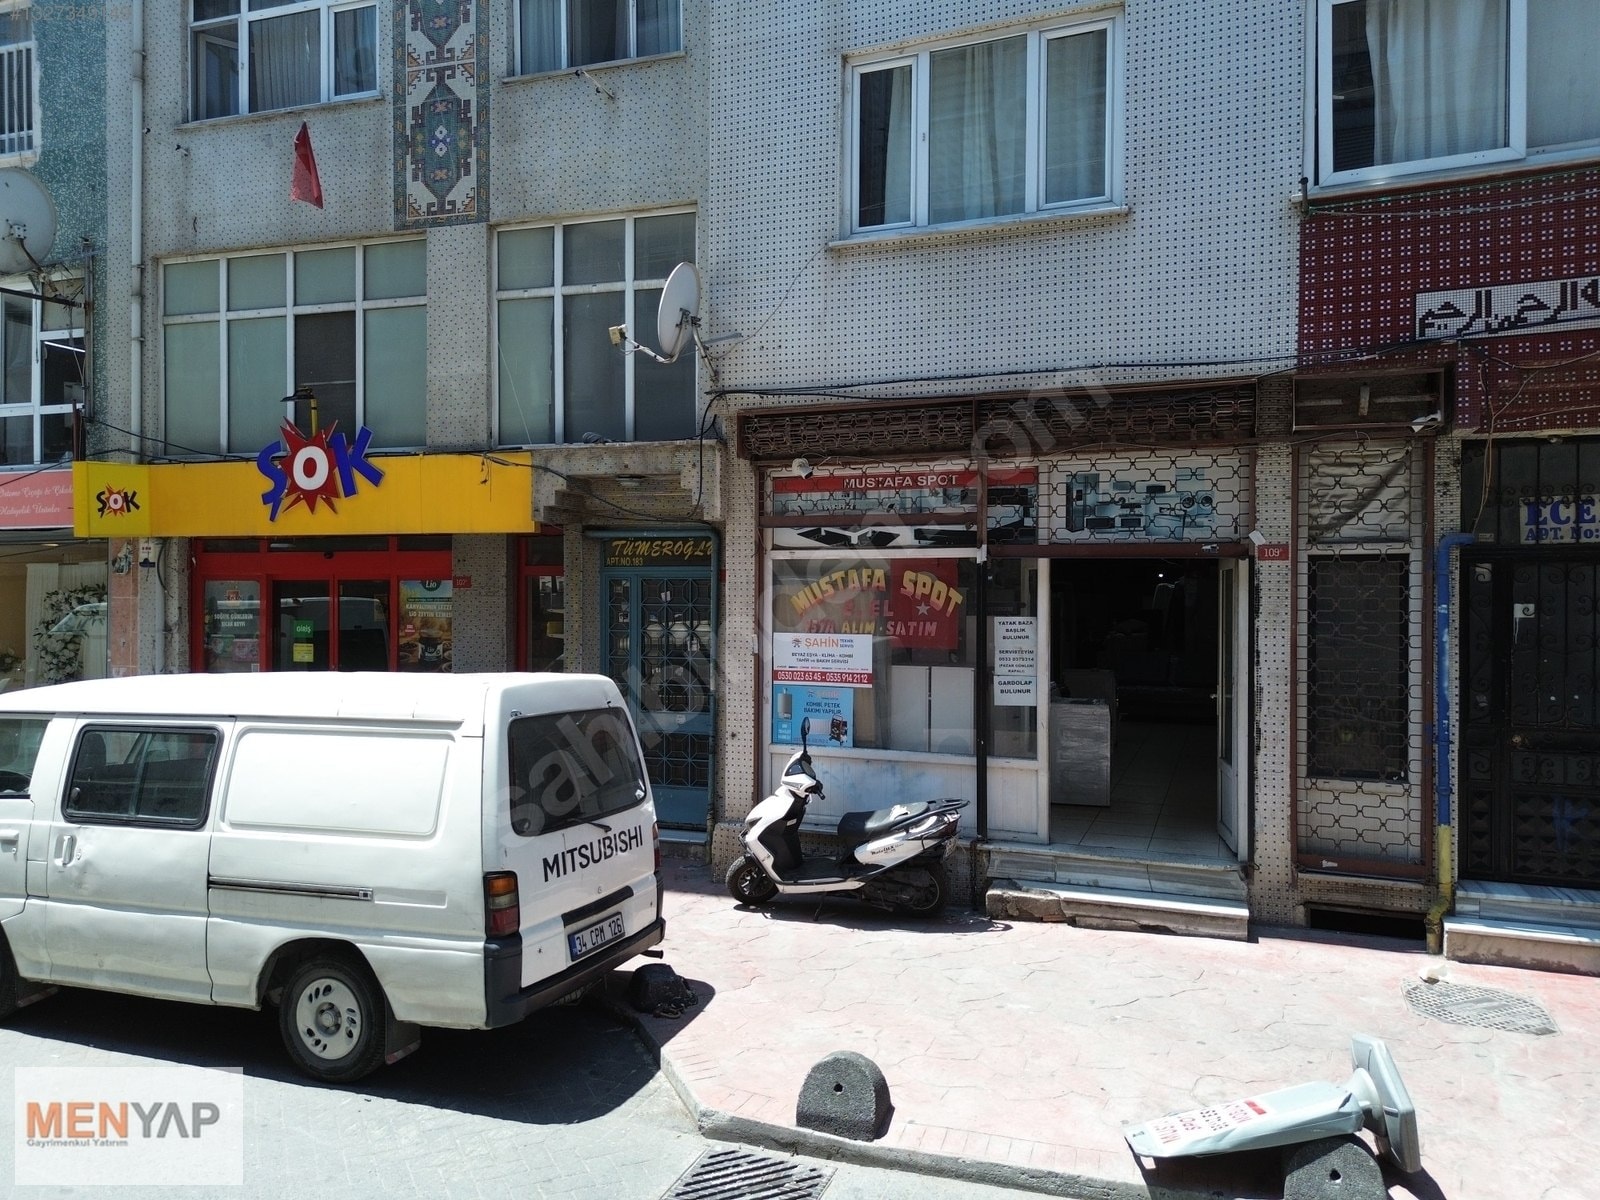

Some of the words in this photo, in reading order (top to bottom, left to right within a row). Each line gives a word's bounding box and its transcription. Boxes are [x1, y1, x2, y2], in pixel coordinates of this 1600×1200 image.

[256, 425, 385, 522] ŞOK
[843, 475, 913, 489] MUSTAFA
[917, 474, 958, 486] SPOT
[96, 490, 141, 518] ŞOK
[790, 568, 886, 618] MUSTAFA
[900, 570, 963, 617] SPOT
[804, 636, 839, 650] ŞAHİN
[886, 621, 938, 637] SATIM
[777, 671, 792, 680] 0530
[793, 672, 804, 680] 023
[805, 672, 812, 681] 63
[813, 673, 821, 681] 45
[826, 673, 841, 682] 0535
[842, 674, 853, 682] 914
[542, 825, 643, 883] MITSUBISHI
[576, 935, 587, 952] 34
[590, 925, 605, 946] CPM
[608, 918, 622, 936] 126
